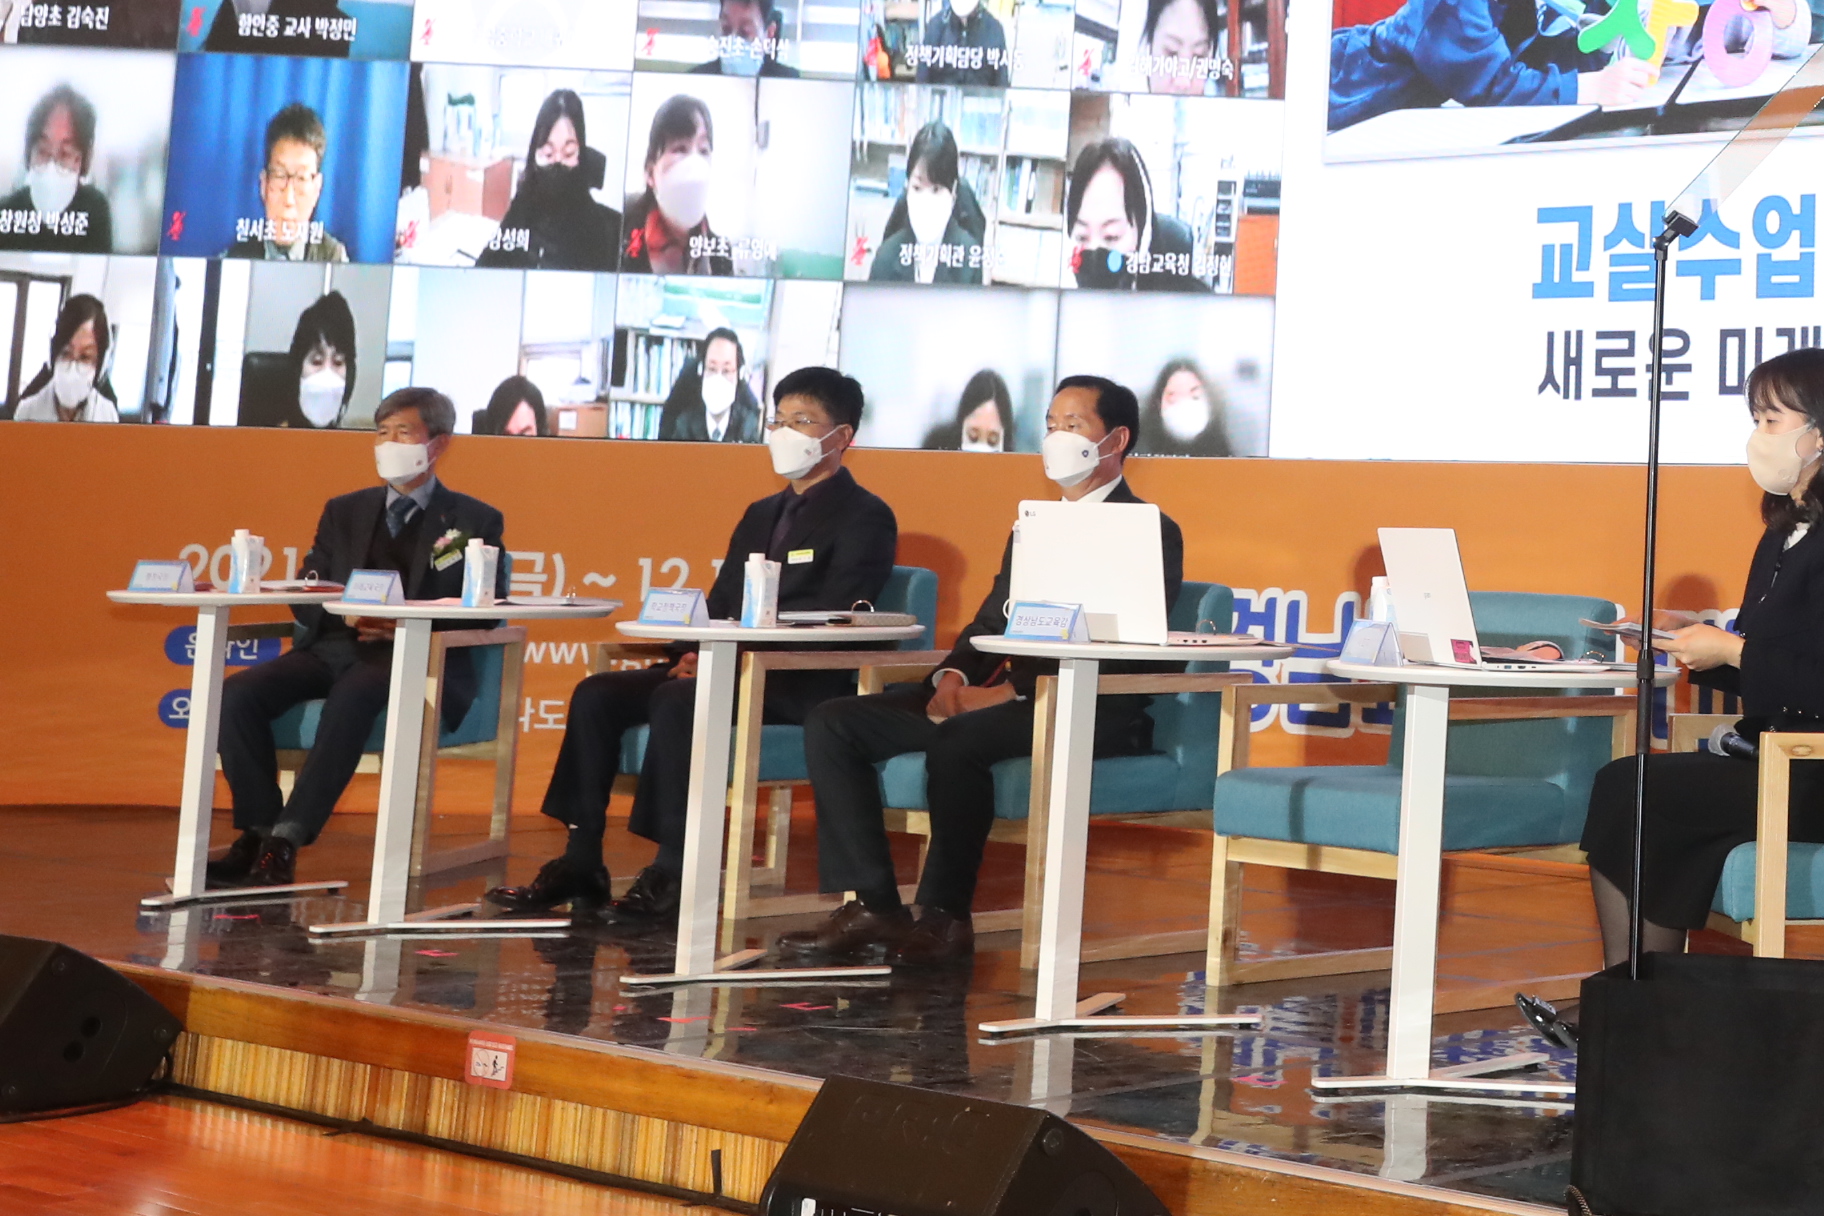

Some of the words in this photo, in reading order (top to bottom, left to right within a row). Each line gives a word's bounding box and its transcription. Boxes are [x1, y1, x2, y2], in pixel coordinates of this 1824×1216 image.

[283, 16, 312, 39] 교사
[1537, 326, 1694, 402] 새로운
[1015, 614, 1069, 629] 경상남도교육감
